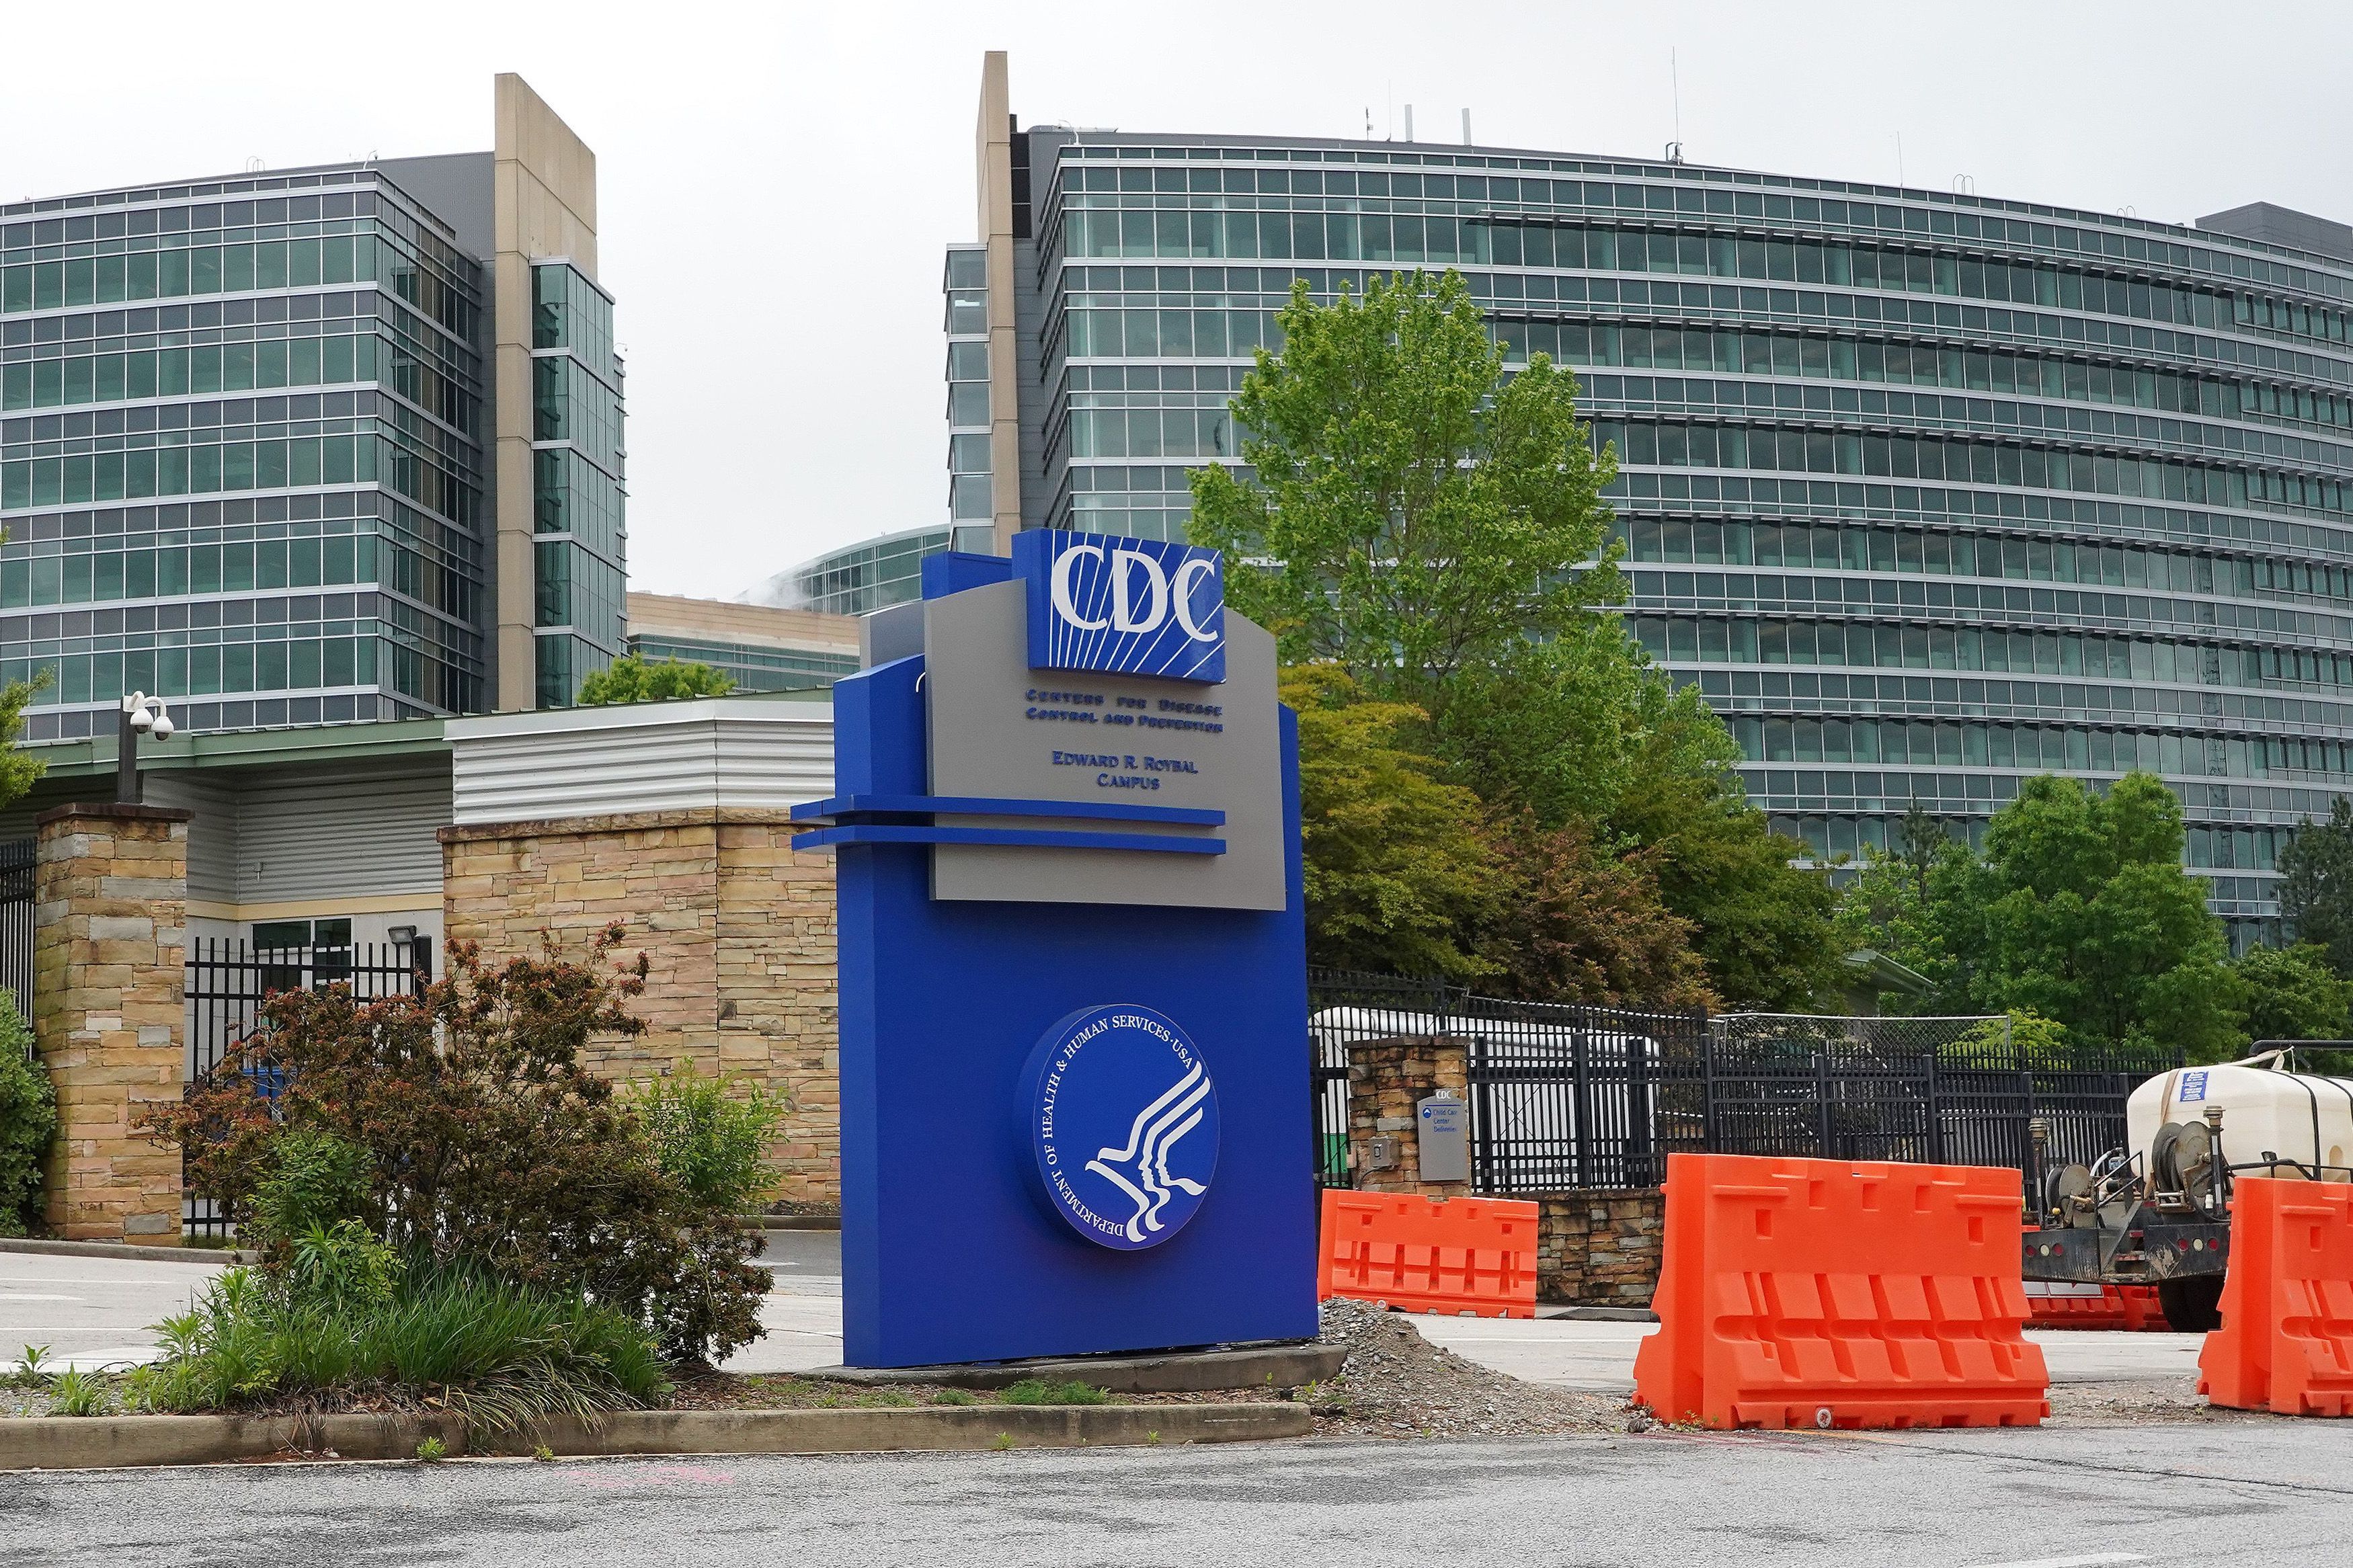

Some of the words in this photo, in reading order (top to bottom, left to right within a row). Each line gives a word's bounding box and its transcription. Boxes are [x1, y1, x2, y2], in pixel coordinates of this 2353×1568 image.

[1051, 545, 1218, 643] CDC
[1026, 689, 1105, 705] CENTERS
[1117, 696, 1147, 709] FOR
[1158, 699, 1223, 716] DISEASE
[1026, 706, 1098, 723] CONTROL
[1103, 714, 1135, 726] AND
[1139, 714, 1224, 733] PREVENTION
[1052, 751, 1119, 768] EDWARD
[1124, 755, 1138, 770] R.
[1144, 756, 1199, 774] ROYBAL
[1096, 773, 1160, 790] CAMPUS
[1063, 1018, 1109, 1060] HUMAN
[1056, 1059, 1068, 1072] &
[1042, 1071, 1062, 1139] HEALTH
[1435, 1090, 1451, 1099] CDC
[1043, 1144, 1058, 1165] OF
[1051, 1169, 1125, 1237] DEPARTMENT
